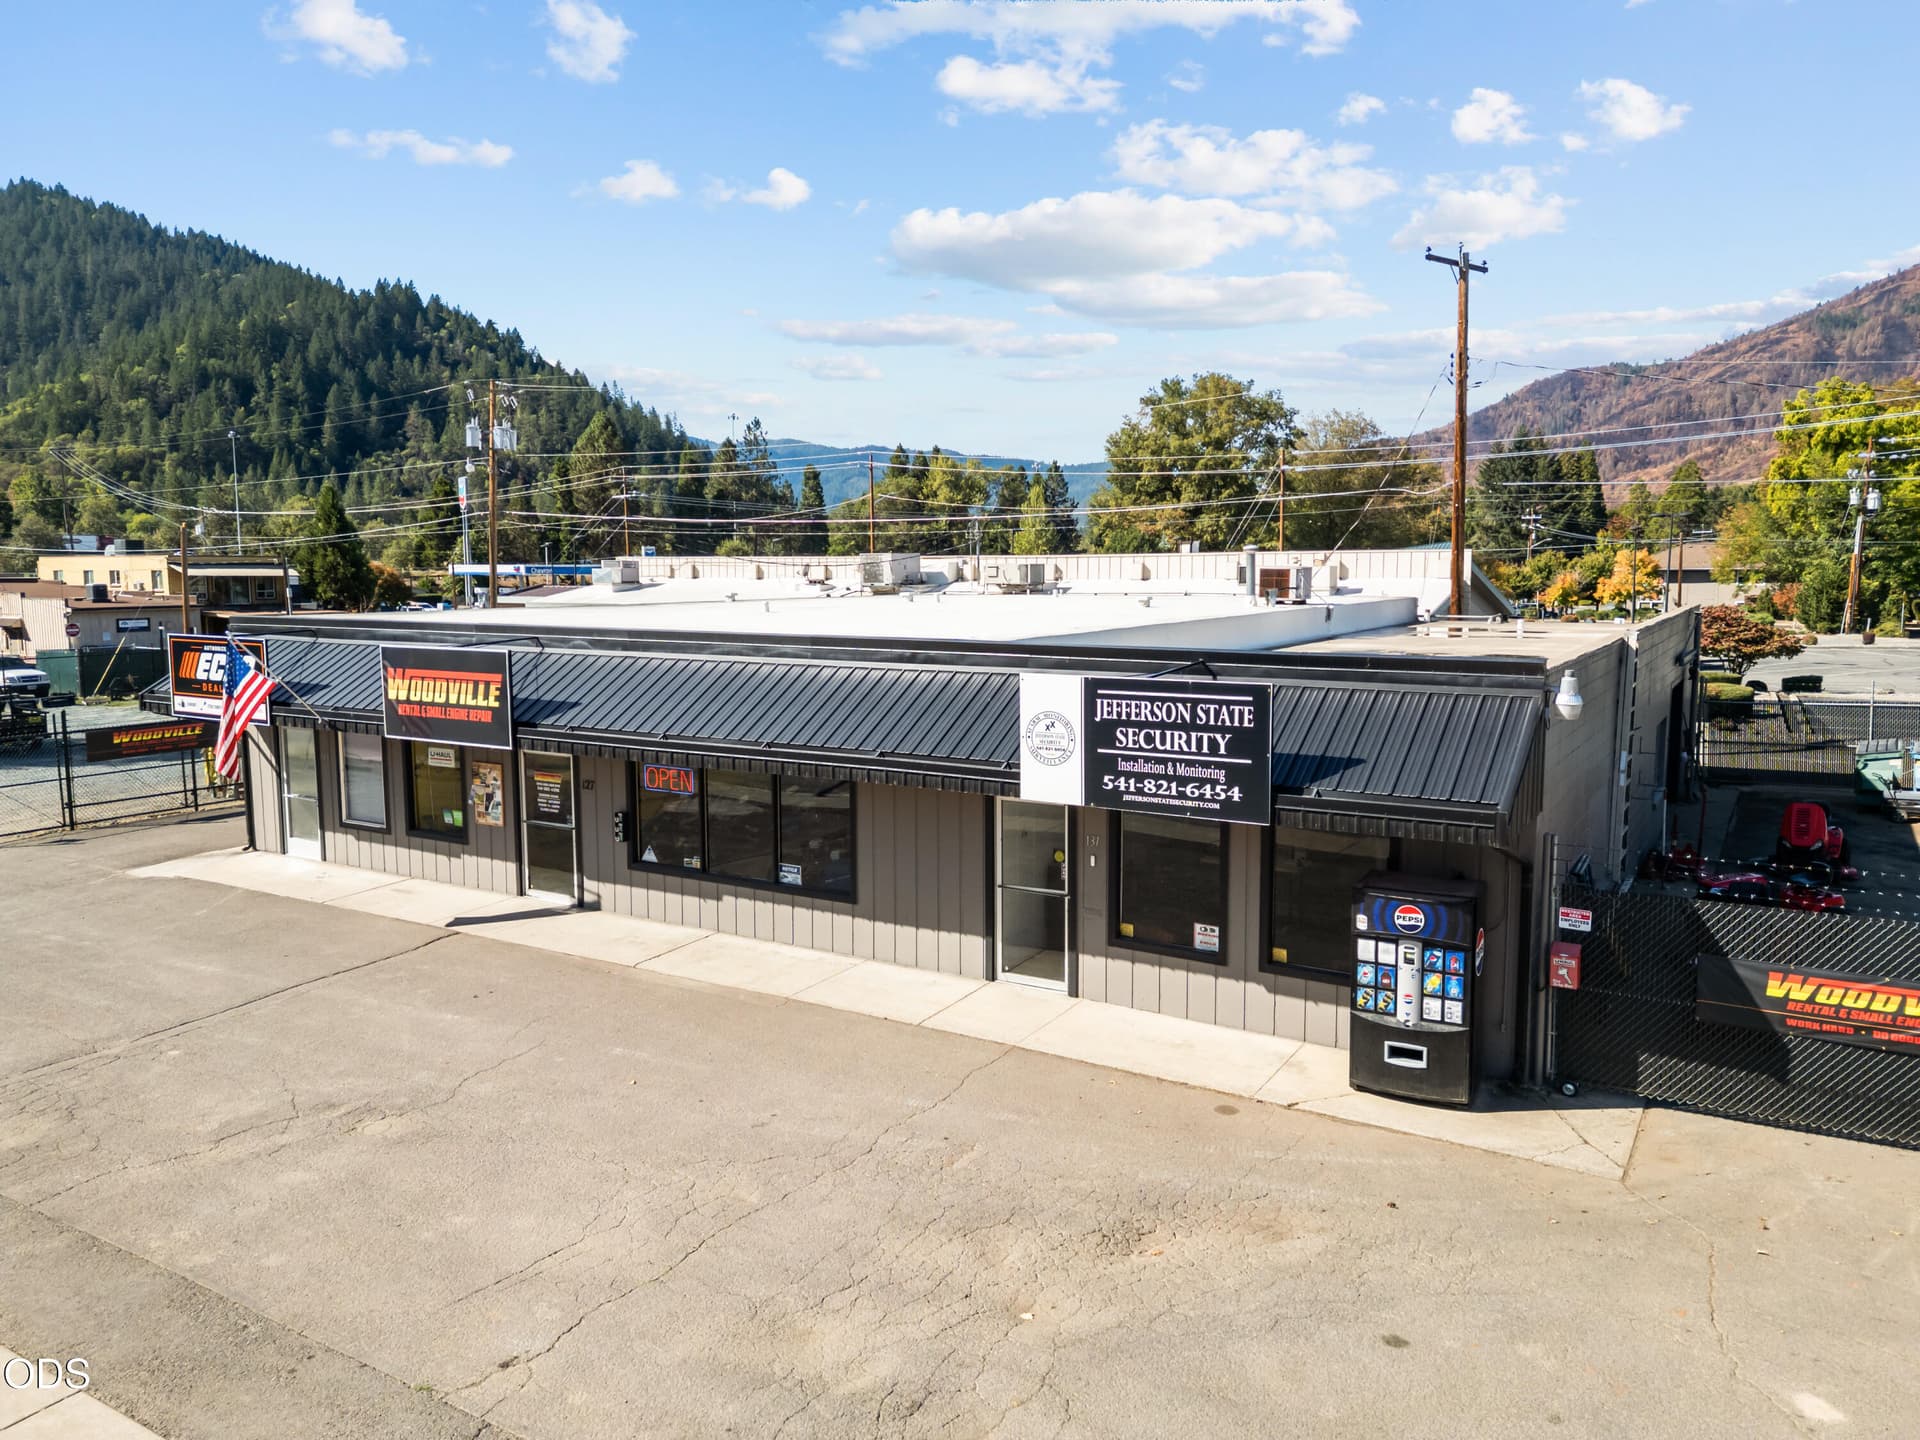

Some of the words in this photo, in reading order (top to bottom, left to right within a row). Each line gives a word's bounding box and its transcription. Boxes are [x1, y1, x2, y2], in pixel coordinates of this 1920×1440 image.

[387, 667, 502, 707] WOODVILLE
[398, 703, 420, 717] RENTAL
[1094, 698, 1192, 724] JEFFERSON
[1197, 703, 1254, 727] STATE
[112, 722, 205, 745] WOODVILLE
[1116, 727, 1233, 754] SECURITY
[646, 767, 693, 792] OPEN
[1117, 757, 1165, 775] Installation
[1166, 761, 1174, 776] &
[1176, 761, 1226, 784] Monitoring
[1102, 774, 1243, 802] 541-821-6454
[1396, 914, 1423, 924] PEPSI
[1786, 1001, 1836, 1017] RENTAL
[1838, 1008, 1849, 1019] &
[1849, 1009, 1893, 1025] SMALL
[1786, 1018, 1820, 1031] WORK
[1822, 1023, 1855, 1035] HARD
